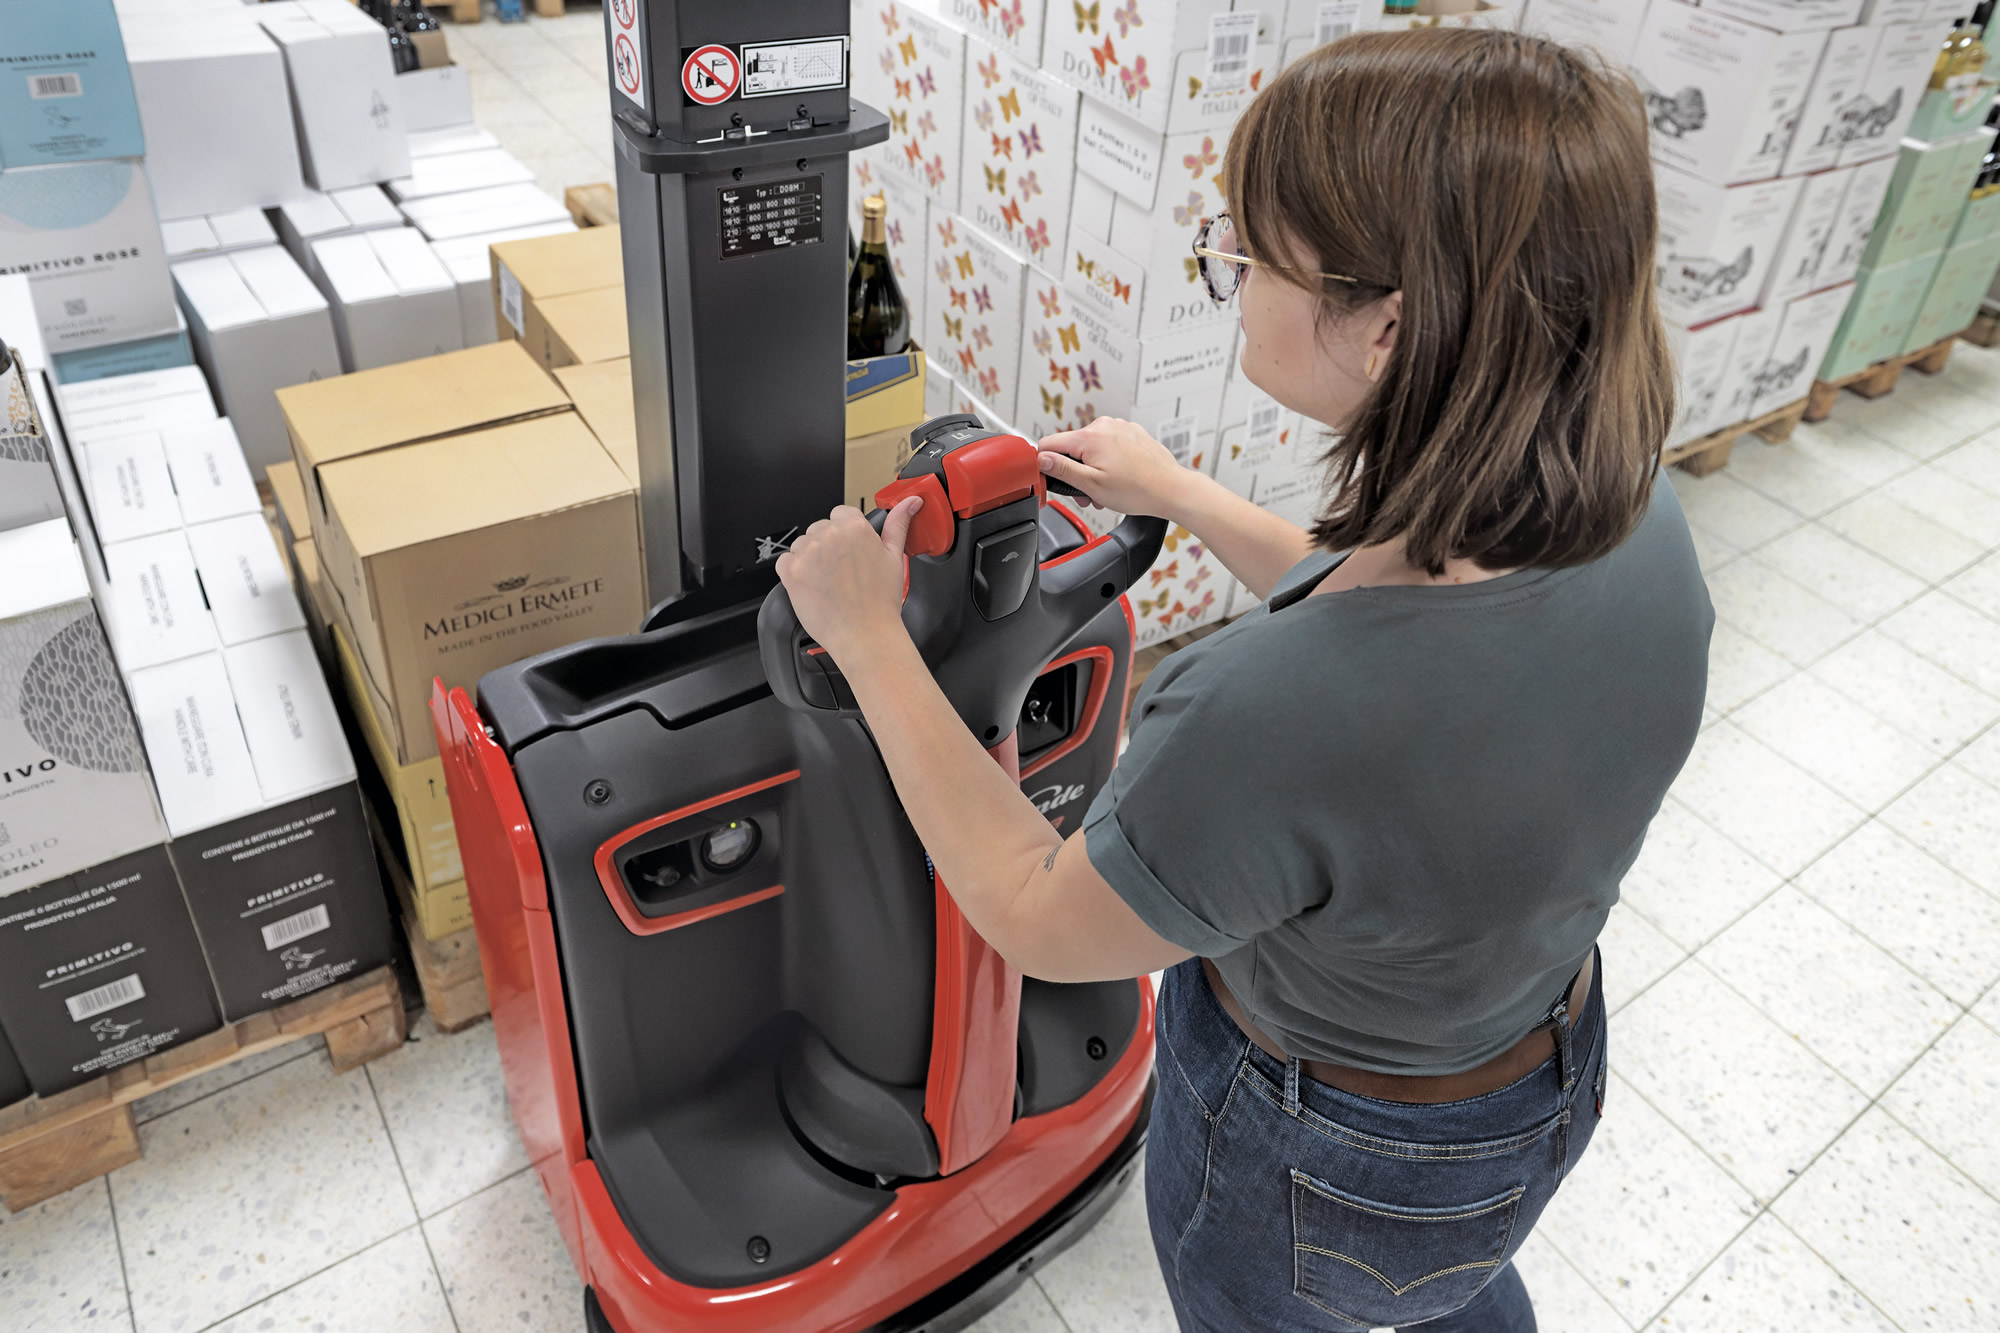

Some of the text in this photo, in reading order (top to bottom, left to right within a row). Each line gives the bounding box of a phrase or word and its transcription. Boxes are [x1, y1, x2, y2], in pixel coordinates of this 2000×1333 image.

[424, 577, 605, 641] MEDICI ERMETE
[438, 604, 594, 655] MADE IN THE FOOD VALLEY
[3, 759, 56, 783] IVO
[1027, 783, 1086, 815] nde
[202, 838, 244, 860] CONTIENE
[0, 858, 45, 879] ETALI
[44, 890, 91, 913] BOTTIGLIE
[91, 885, 107, 897] DA
[247, 873, 324, 908] PRIMITIVO
[24, 895, 117, 932] PRODOTTO IN ITALIA
[46, 941, 133, 978] PRIMITIVO
